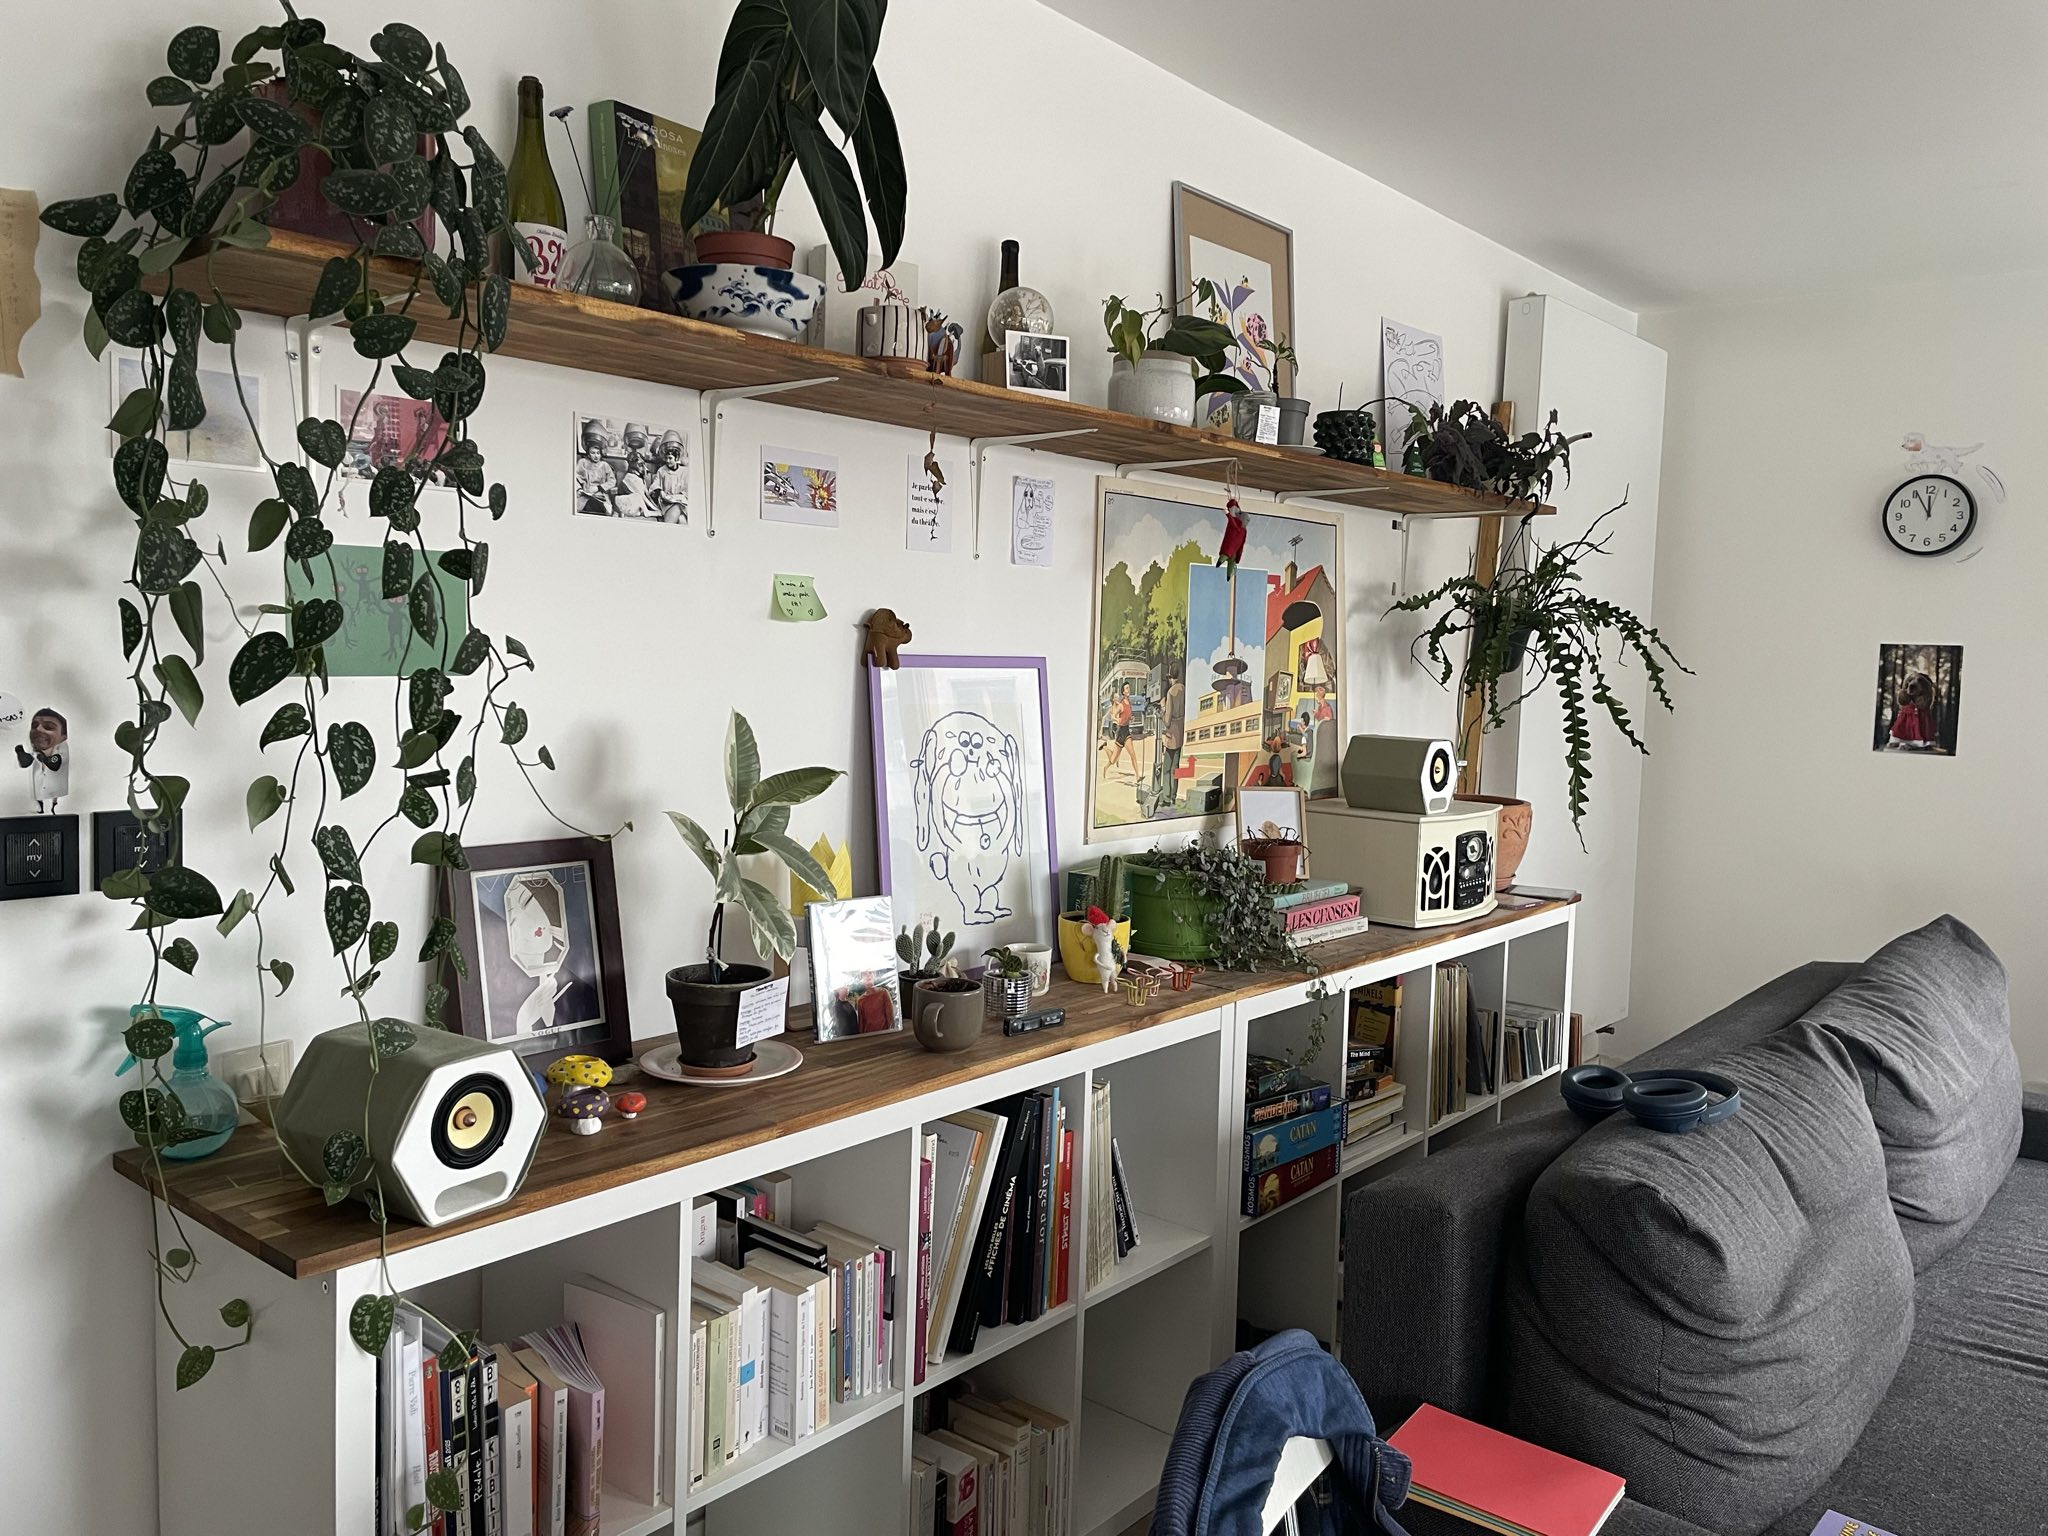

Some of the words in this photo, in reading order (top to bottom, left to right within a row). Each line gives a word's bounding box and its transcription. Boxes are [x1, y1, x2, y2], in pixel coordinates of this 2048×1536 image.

[1925, 485, 1936, 494] 12
[1900, 499, 1911, 508] 10
[1952, 498, 1960, 507] 2
[911, 506, 925, 514] mais
[1895, 512, 1902, 521] 9
[1956, 511, 1964, 520] 3
[911, 516, 919, 525] du
[1898, 525, 1906, 534] 8
[1950, 524, 1957, 532] 4
[1909, 534, 1916, 542] 7
[1923, 537, 1930, 546] 6
[1938, 533, 1946, 542] 5
[134, 845, 149, 854] my
[26, 853, 42, 862] my
[1291, 911, 1312, 931] LES
[1359, 1050, 1371, 1058] Mind
[1253, 1098, 1298, 1123] PANDEMIC
[1289, 1119, 1317, 1143] CATAN
[1243, 1133, 1251, 1172] KOSMOS
[1290, 1156, 1314, 1180] CATAN
[1001, 1175, 1018, 1215] CINÉMA
[1246, 1176, 1255, 1215] KOSMOS
[1062, 1191, 1071, 1210] ART
[998, 1215, 1007, 1230] DE
[698, 1215, 706, 1246] Aragon
[1061, 1213, 1070, 1250] STREET
[986, 1230, 1004, 1278] AFFICHES
[408, 1369, 417, 1395] Pierre
[472, 1458, 483, 1503] Pédale
